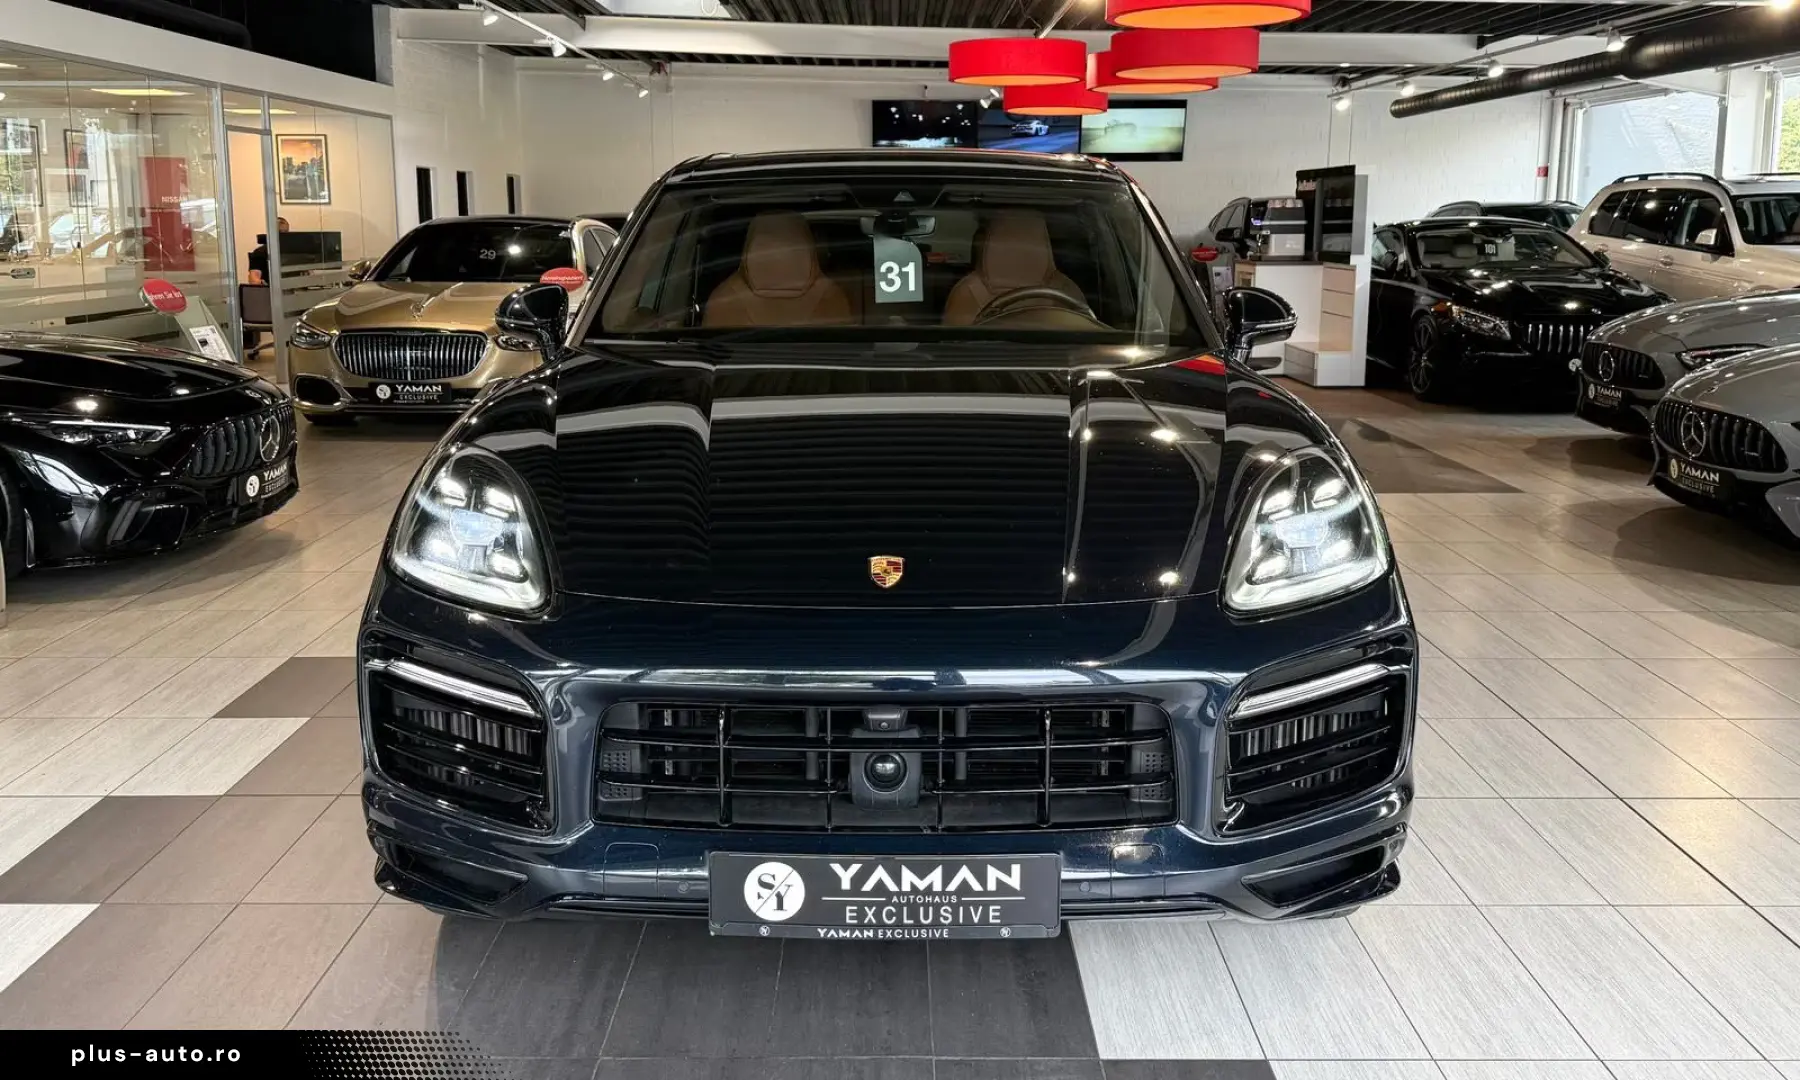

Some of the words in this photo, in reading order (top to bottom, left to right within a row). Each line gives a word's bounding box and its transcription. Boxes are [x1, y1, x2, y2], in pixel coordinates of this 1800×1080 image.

[479, 248, 496, 260] 29
[879, 261, 915, 293] 31
[395, 384, 442, 393] YAMAN
[1680, 461, 1720, 483] YAMAN
[829, 863, 1021, 892] YAMAN
[891, 895, 957, 904] AUTOHAUS
[845, 906, 1002, 925] EXCLUSIVE
[817, 928, 874, 938] YAMAN
[878, 928, 950, 939] EXCLUSIVE
